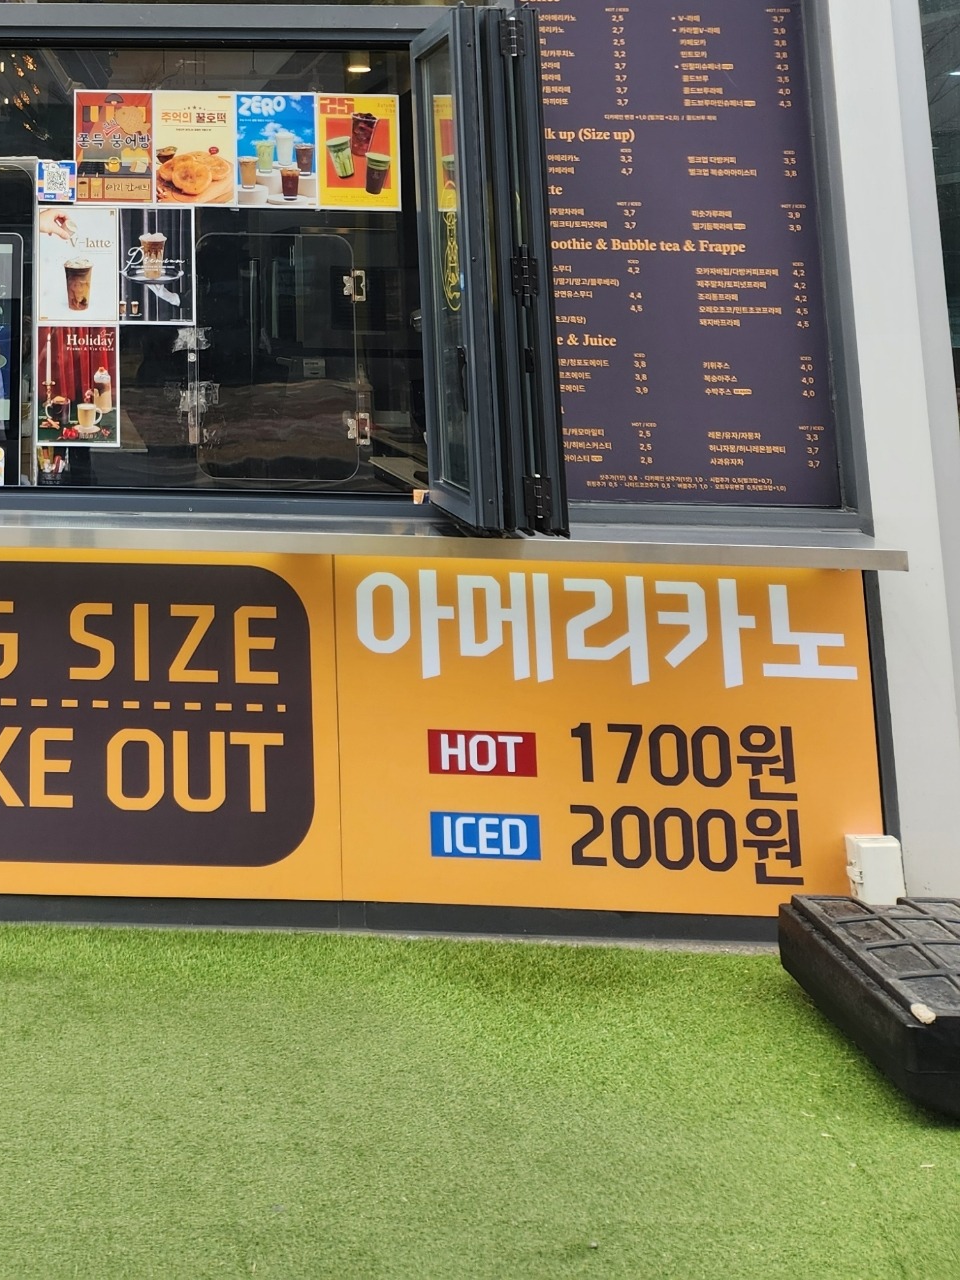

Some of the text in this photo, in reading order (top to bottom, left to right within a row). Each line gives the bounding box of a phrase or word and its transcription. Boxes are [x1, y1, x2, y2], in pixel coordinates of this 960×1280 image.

[238, 96, 286, 117] ZERO
[161, 112, 227, 124] 추억의 꿀호떡
[110, 132, 151, 149] 붕어빵
[558, 131, 575, 142] up
[578, 128, 611, 142] (Size
[613, 129, 635, 143] up)
[551, 238, 746, 255] oothie & Bubble tea & Frappe
[66, 334, 115, 348] Holiday
[566, 333, 579, 346] &
[582, 334, 617, 346] Juice
[800, 364, 813, 372] 4,0
[801, 377, 814, 385] 4,0
[802, 390, 815, 398] 4,0
[355, 569, 859, 689] 아메리카노
[68, 602, 279, 685] SIZE
[106, 727, 284, 813] OUT
[440, 722, 799, 802] HOT 1700원
[442, 804, 805, 886] ICED 2000원
